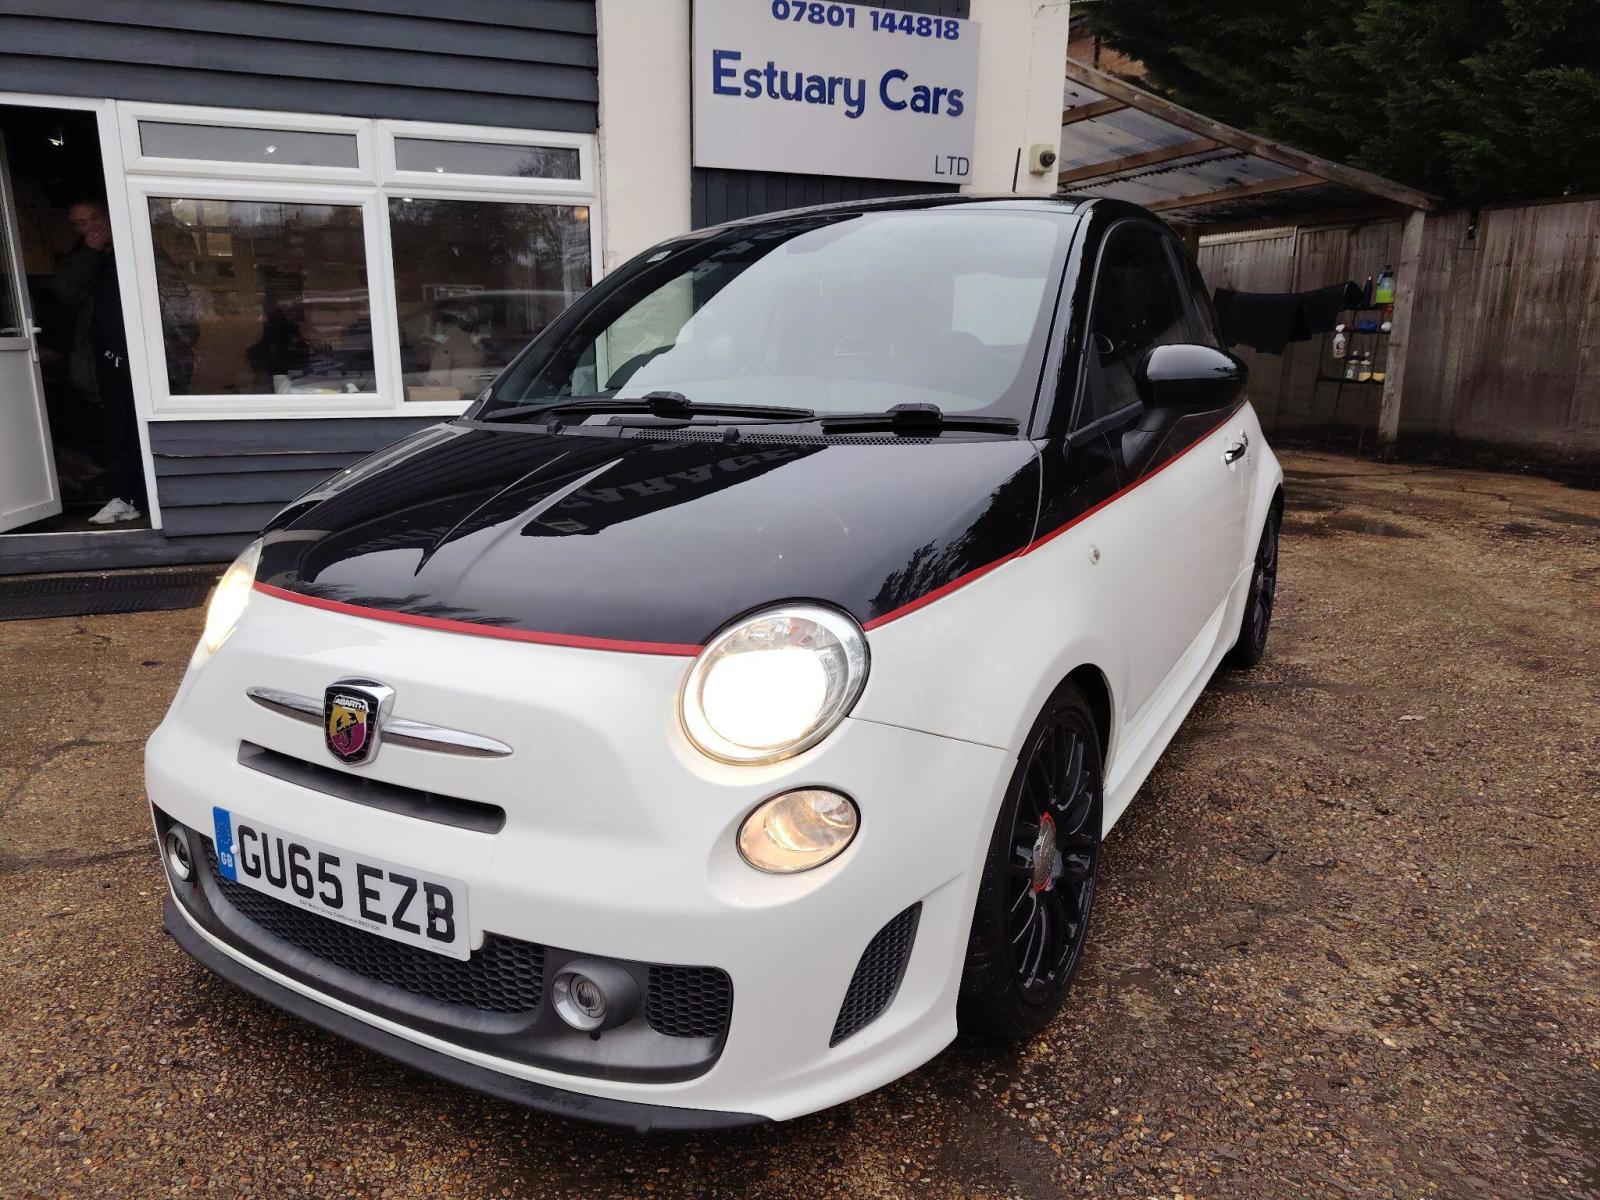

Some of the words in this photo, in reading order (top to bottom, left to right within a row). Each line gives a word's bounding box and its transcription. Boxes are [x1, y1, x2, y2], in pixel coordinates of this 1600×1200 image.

[771, 0, 855, 28] 07801
[870, 10, 960, 40] 144818
[712, 49, 866, 119] Estuary
[879, 68, 964, 117] Cars
[935, 155, 970, 176] LTD
[333, 697, 368, 712] ABARTH
[220, 851, 234, 868] GB
[237, 824, 344, 909] GU65
[356, 862, 456, 944] EZB
